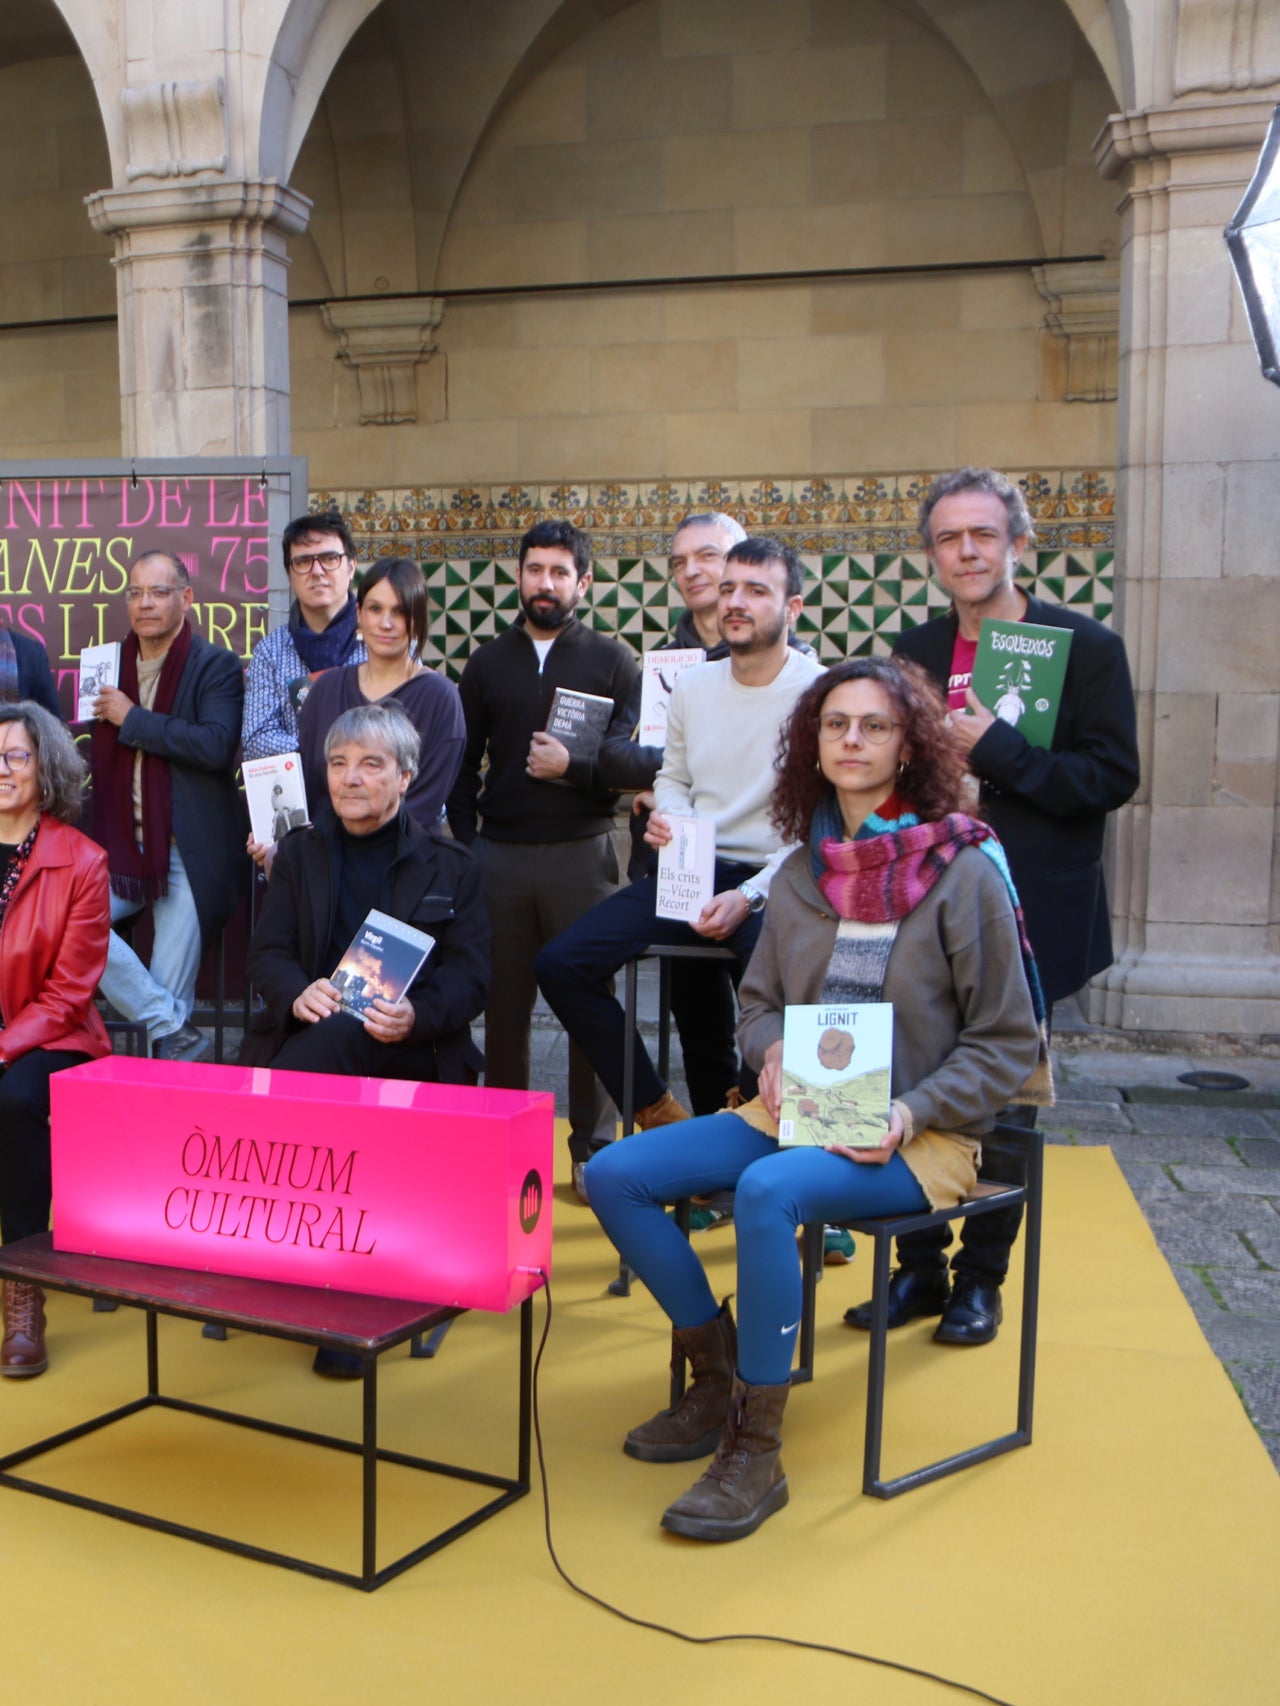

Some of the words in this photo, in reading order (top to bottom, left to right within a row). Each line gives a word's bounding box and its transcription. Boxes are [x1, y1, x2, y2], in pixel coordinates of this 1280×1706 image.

[4, 479, 105, 529] NIT
[116, 479, 193, 528] DE
[991, 630, 1057, 660] ESQUEIXOS
[559, 695, 586, 711] GUERRA
[660, 867, 675, 880] Els
[677, 871, 701, 884] crits
[659, 895, 690, 911] Recort
[364, 930, 384, 945] Virgil
[817, 1011, 859, 1026] LIGNIT
[180, 1125, 361, 1196] ÒMNIUM
[163, 1186, 378, 1256] CULTURAL
